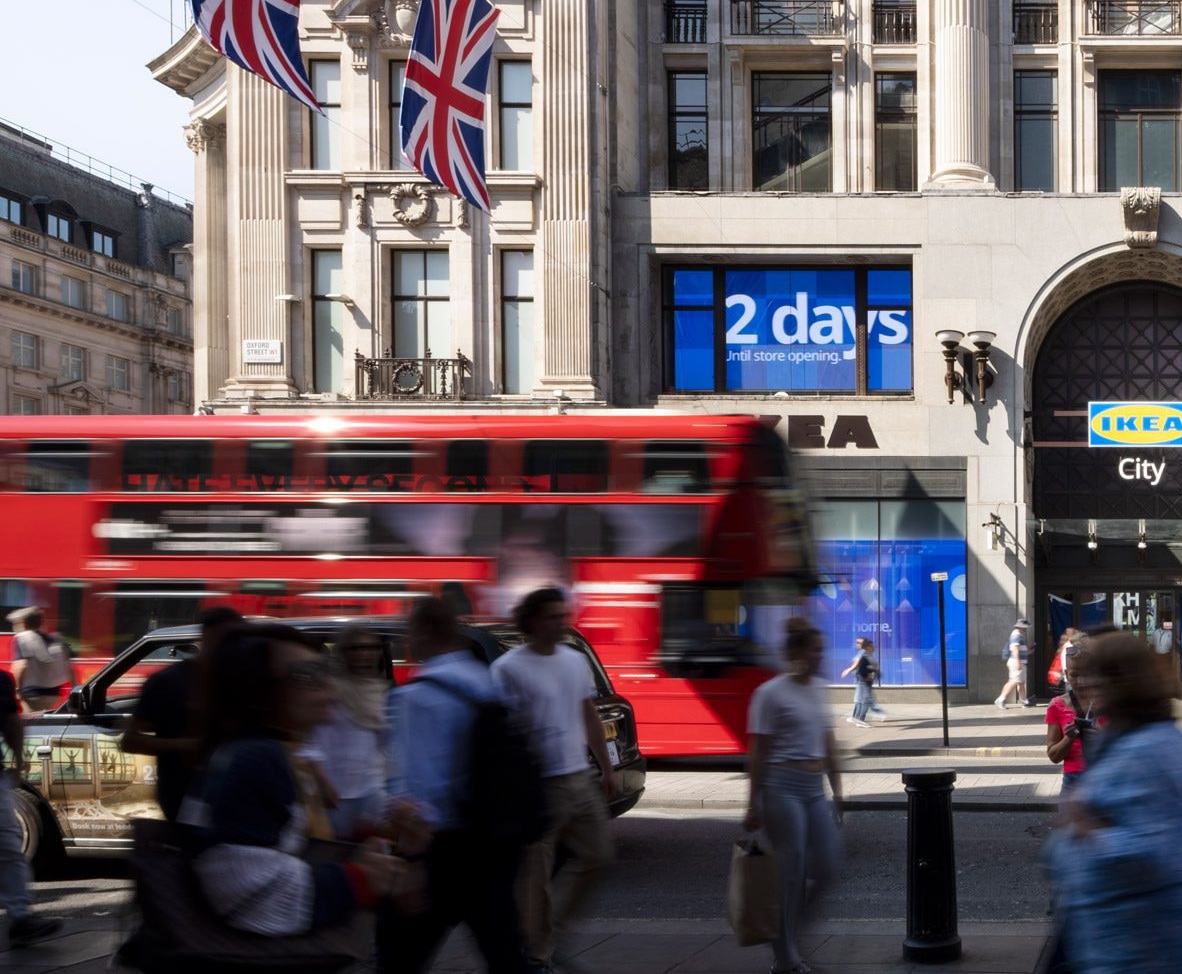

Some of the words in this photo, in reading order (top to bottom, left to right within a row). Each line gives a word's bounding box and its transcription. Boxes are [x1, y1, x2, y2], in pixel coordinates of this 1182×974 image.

[725, 294, 758, 344] 2
[772, 292, 908, 360] days
[753, 352, 785, 362] store
[788, 350, 842, 365] opening.
[1118, 457, 1166, 485] City
